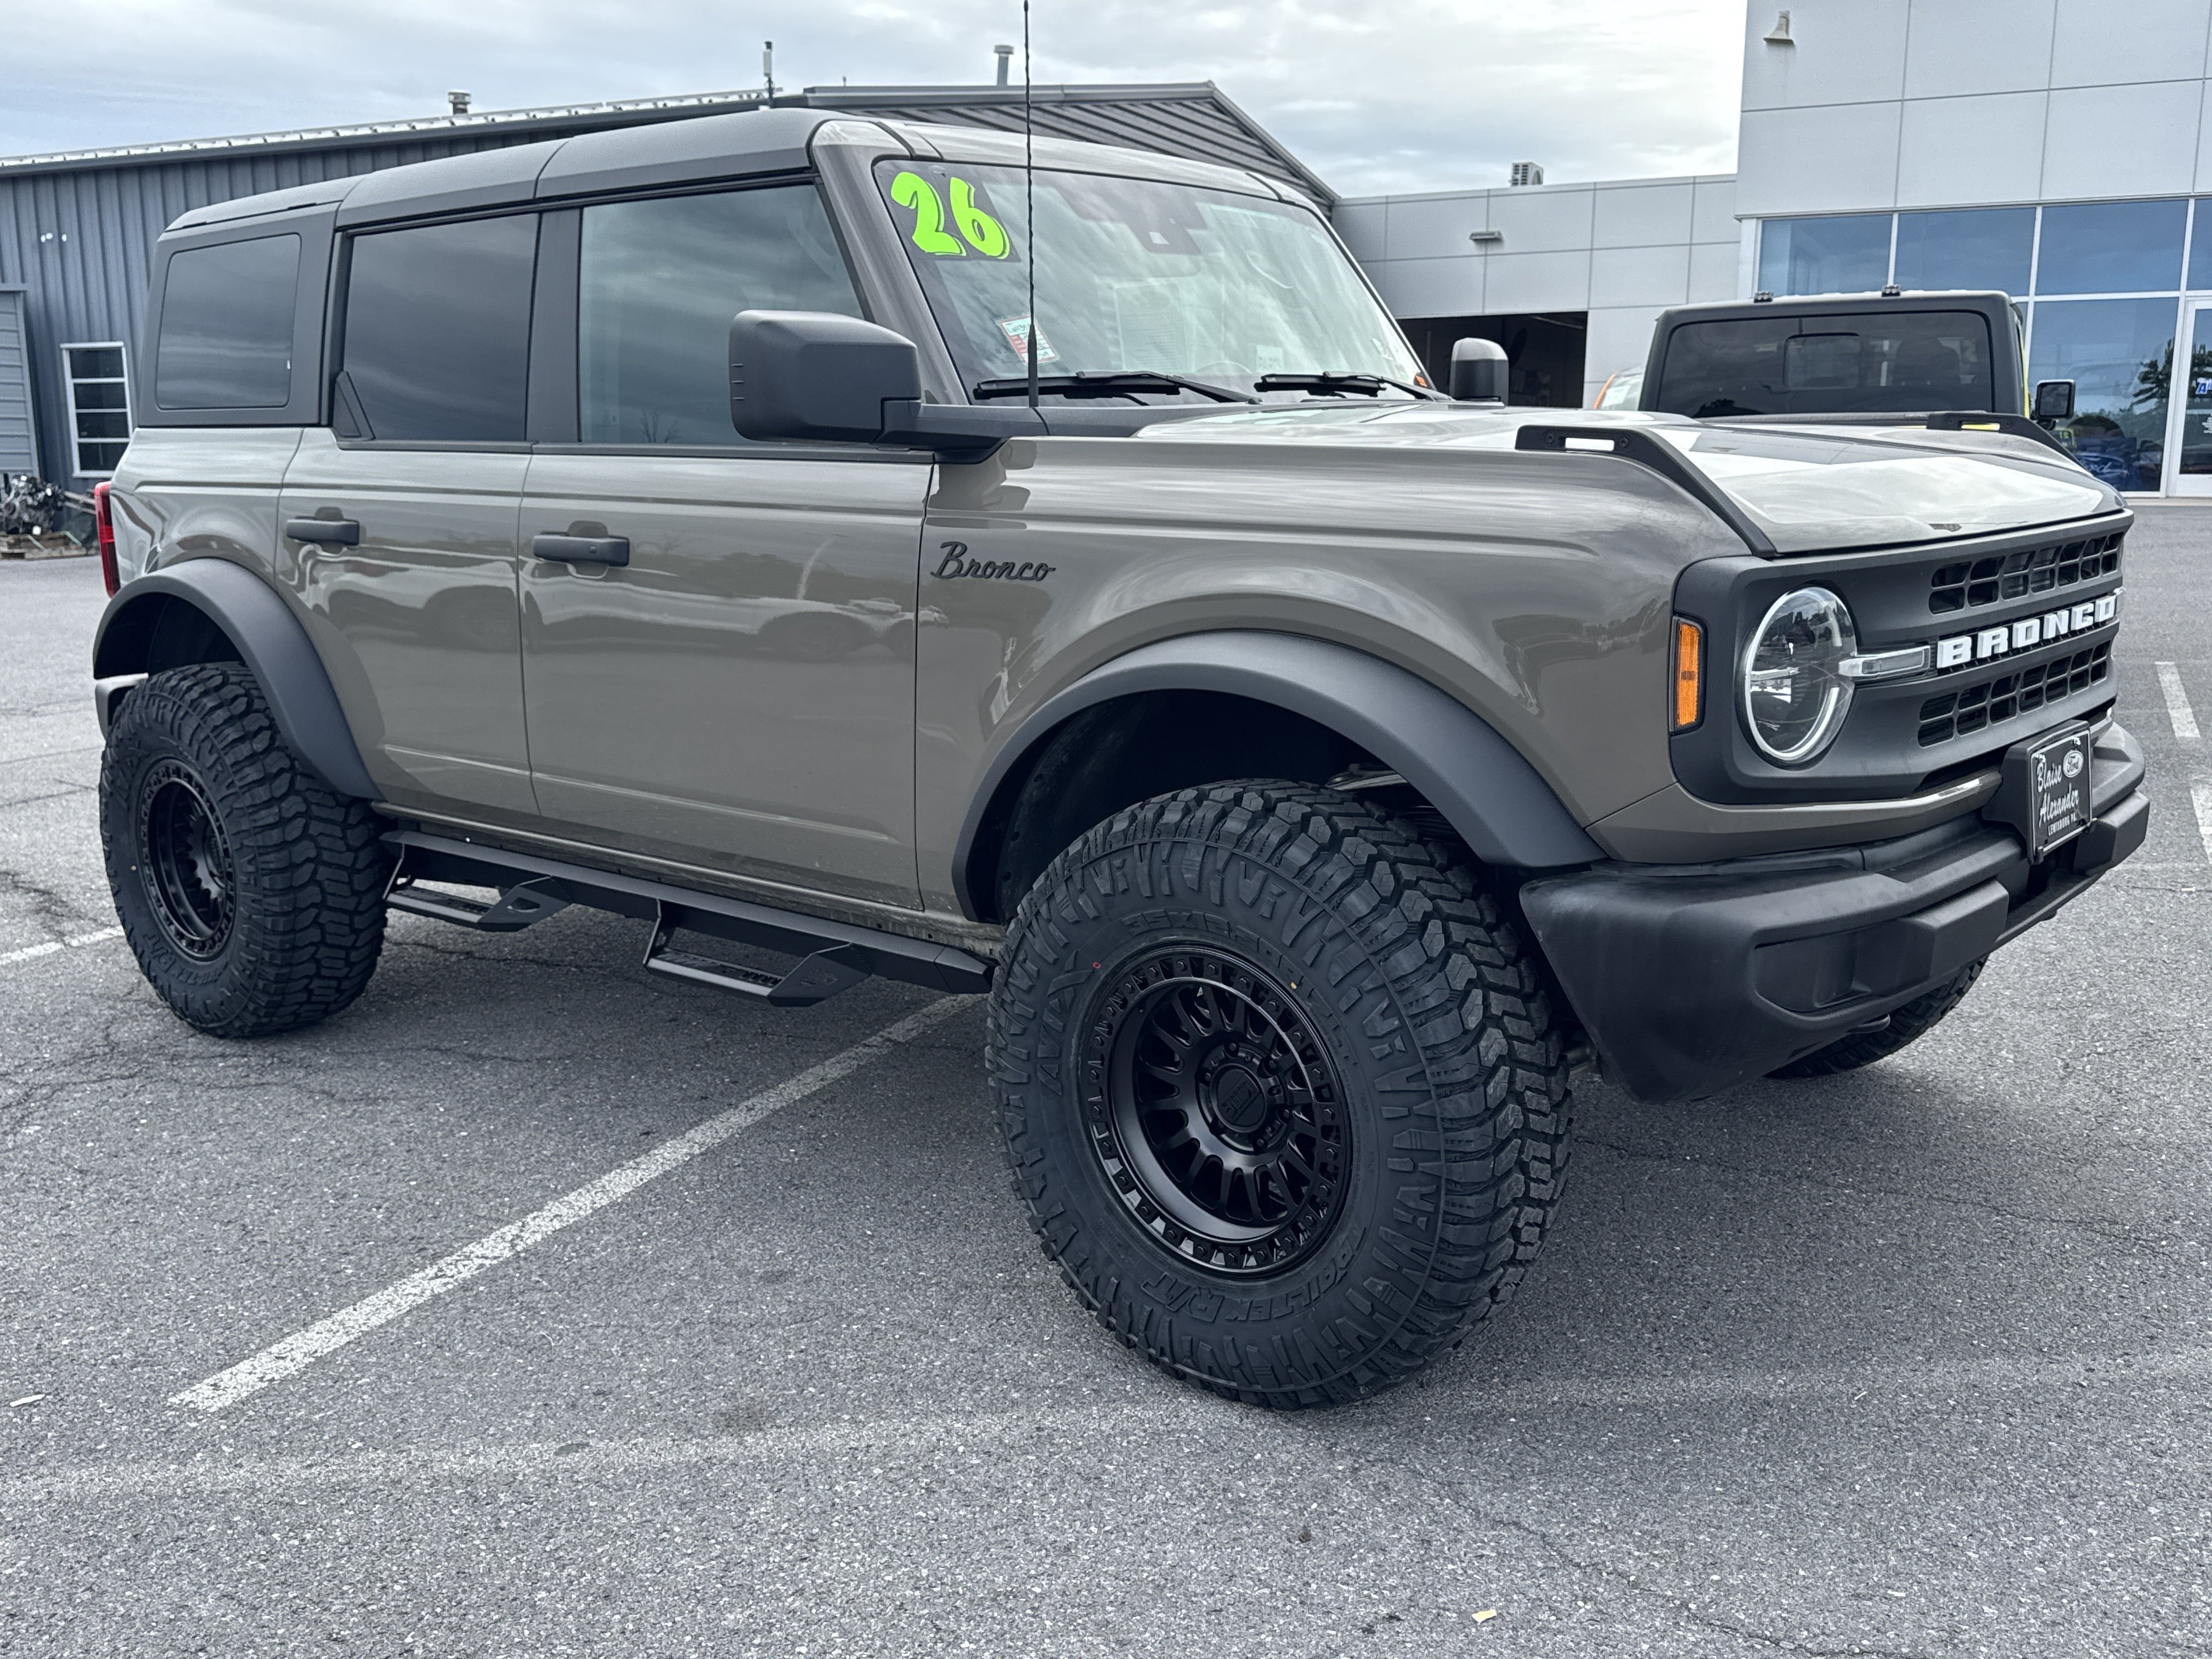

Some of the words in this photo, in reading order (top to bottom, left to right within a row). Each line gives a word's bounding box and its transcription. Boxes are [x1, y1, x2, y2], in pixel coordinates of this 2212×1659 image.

[891, 172, 1010, 259] 26
[930, 541, 1056, 582] Bronco
[1937, 595, 2117, 669] BRONCO
[2036, 760, 2063, 793] Blaise
[2067, 755, 2080, 774] Ford
[2039, 782, 2079, 828] Alexander
[2047, 815, 2070, 837] LEWISBURG
[1141, 1272, 1225, 1323] R/T
[1223, 1227, 1368, 1322] TRAILTEK
